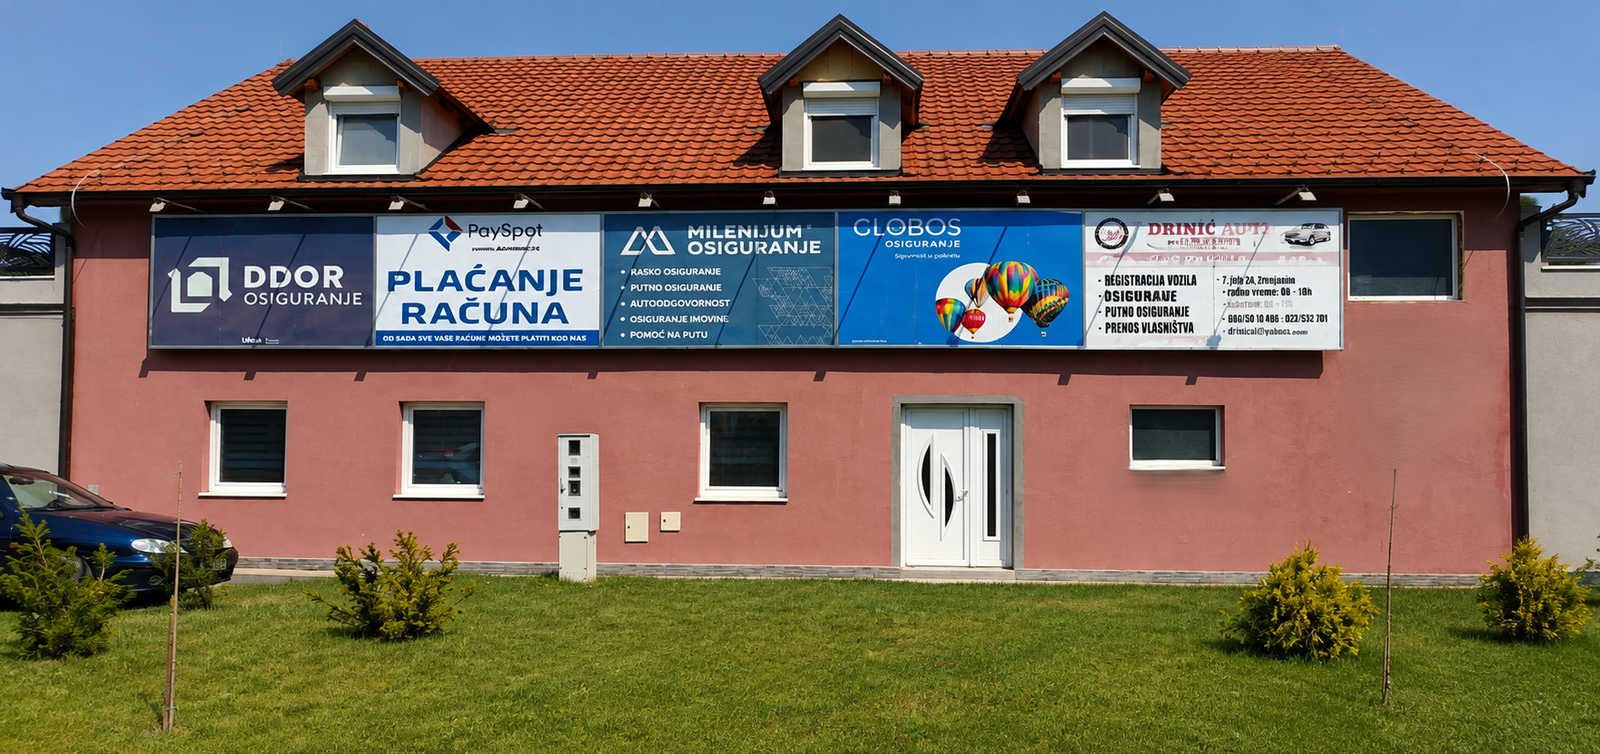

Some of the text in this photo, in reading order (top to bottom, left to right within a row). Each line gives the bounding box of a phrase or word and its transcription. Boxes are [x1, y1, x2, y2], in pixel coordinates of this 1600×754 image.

[468, 223, 543, 241] PaySpot
[687, 225, 802, 239] MILENIJUM
[853, 218, 961, 236] GLOBOS
[1147, 219, 1216, 236] DRINIĆ
[687, 240, 821, 255] OSIGURANJE
[884, 240, 961, 248] OSIGURANJE
[244, 265, 344, 288] DDOR
[663, 268, 722, 276] OSIGURANJE
[387, 264, 584, 297] PLAĆANJE
[1104, 274, 1198, 286] REGISTRACIJA VOZILA
[630, 284, 722, 292] PUTNO OSIGURANJE
[1251, 287, 1279, 296] vreme:
[243, 292, 363, 305] OSIGURANJE
[630, 299, 731, 308] AUTOODGOVORNOST
[401, 297, 570, 325] RAČUNA
[1105, 306, 1190, 318] PUTNO OSIGURANJE
[630, 315, 730, 324] OSIGURANJE IMOVINE
[1256, 314, 1264, 322] 10
[1105, 319, 1195, 334] PRENOS VLASNIŠTVA
[630, 329, 666, 339] POMOĆ
[683, 331, 708, 339] PUTU
